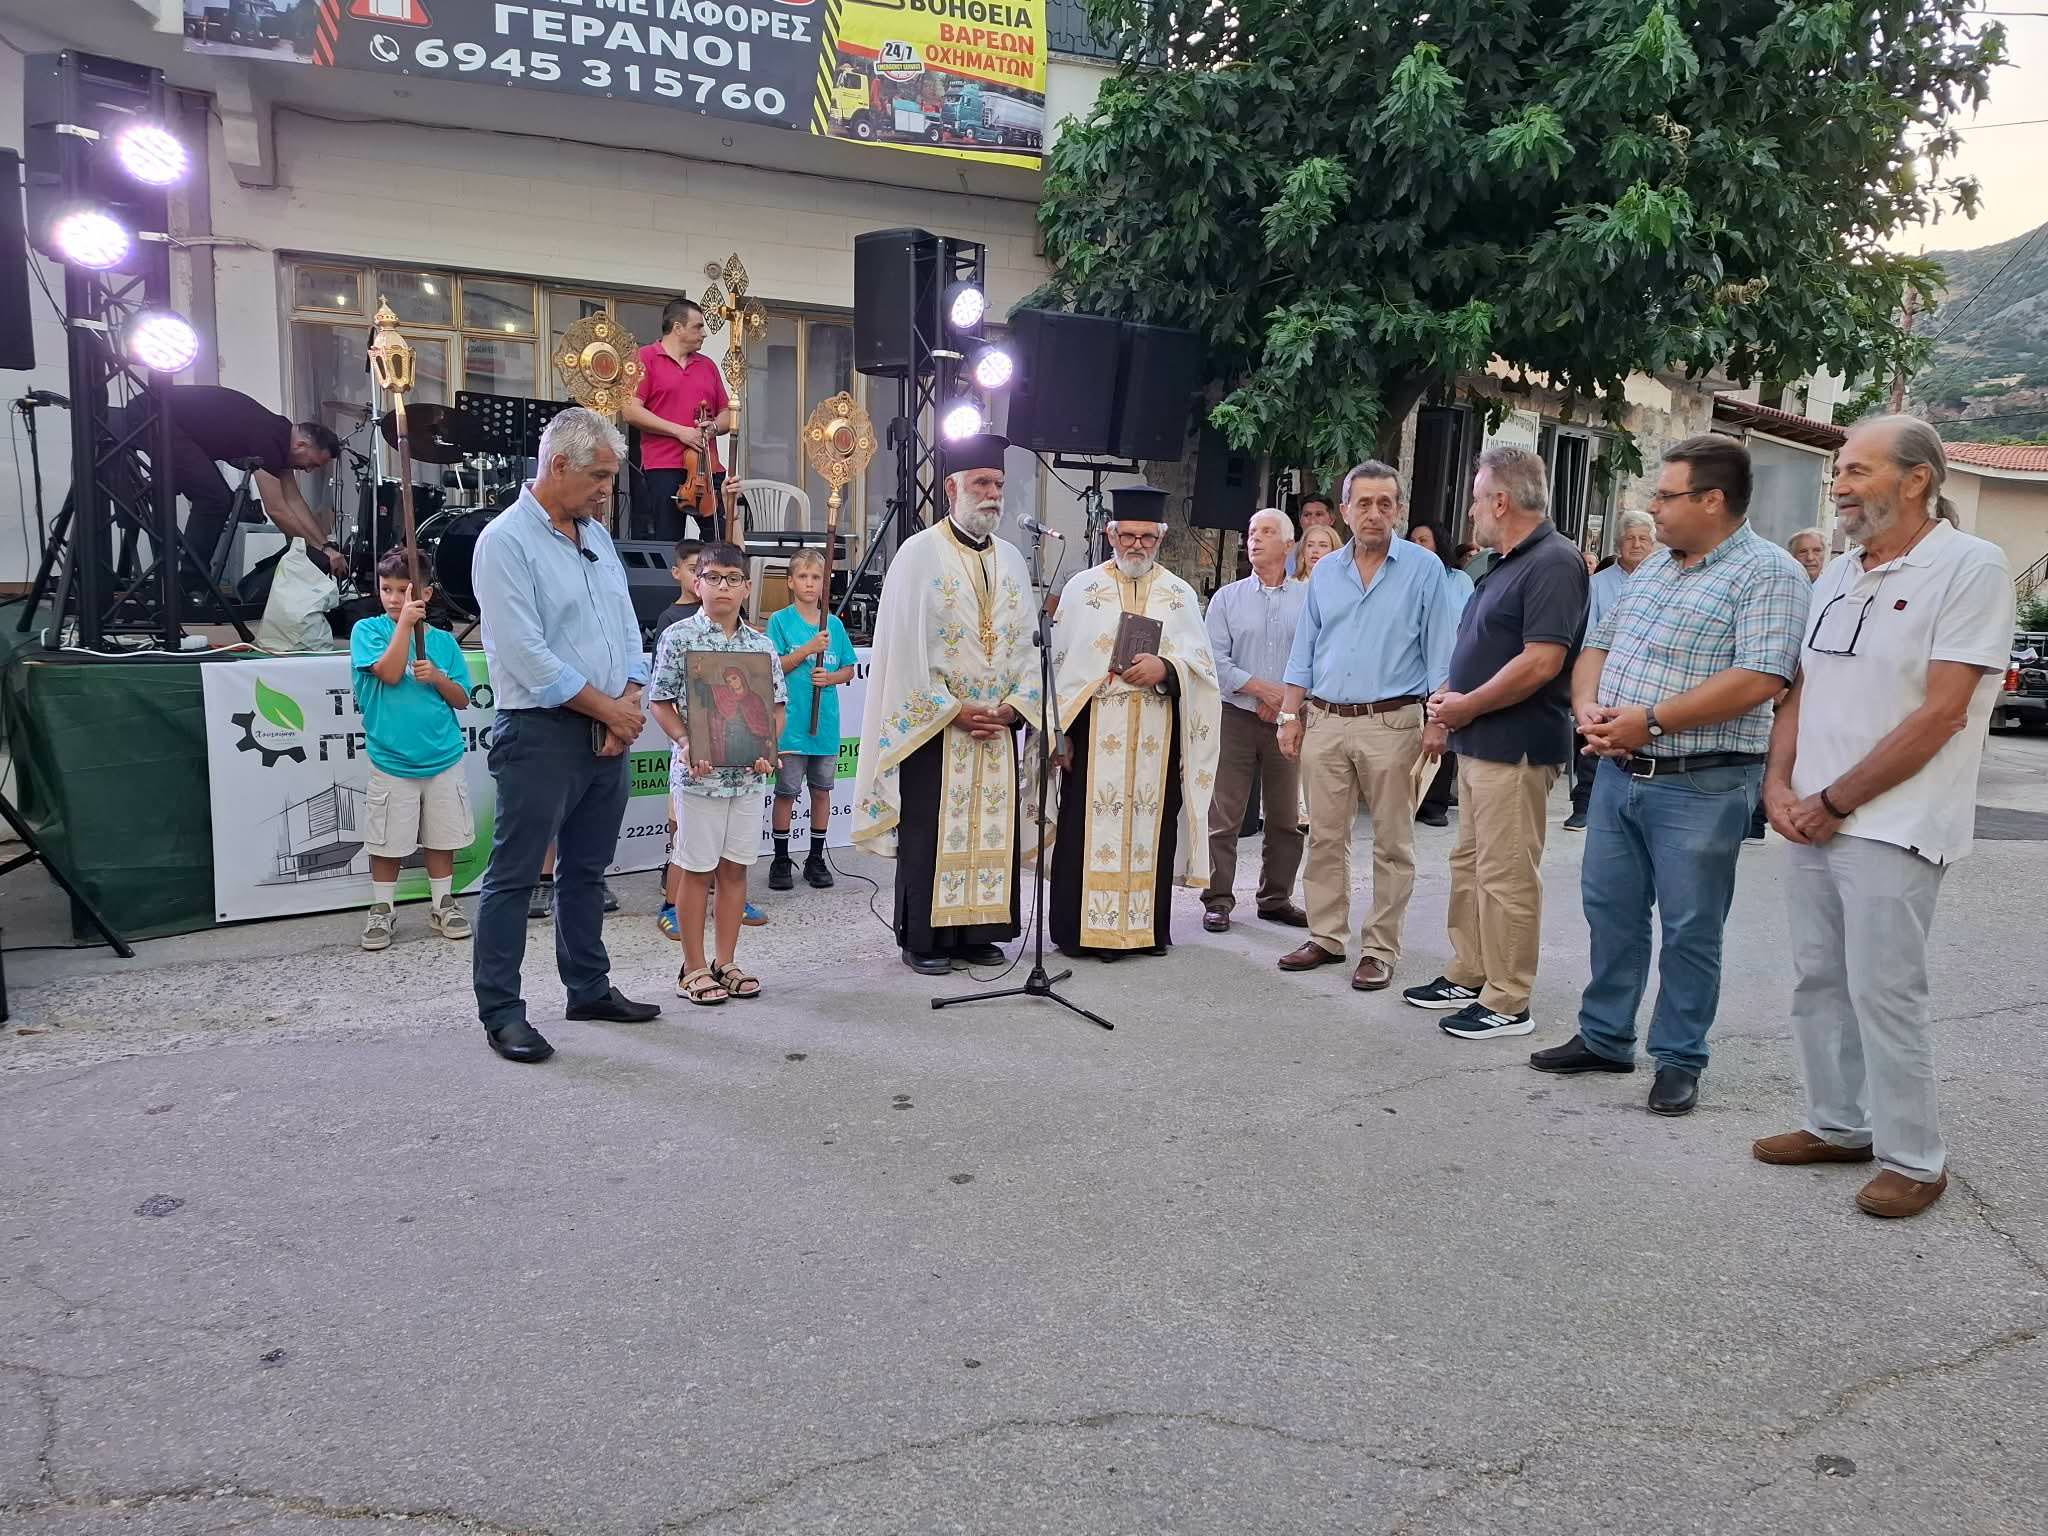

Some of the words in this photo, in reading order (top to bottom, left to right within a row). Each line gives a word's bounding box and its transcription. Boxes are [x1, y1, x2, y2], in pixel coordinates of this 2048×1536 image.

[494, 3, 751, 72] ΓΕΡΑΝΟΙ
[925, 44, 1034, 79] ΟΧΗΜΑΤΩΝ
[939, 22, 1035, 56] ΒΑΡΕΩΝ
[414, 38, 562, 81] 6945
[581, 58, 786, 115] 315760
